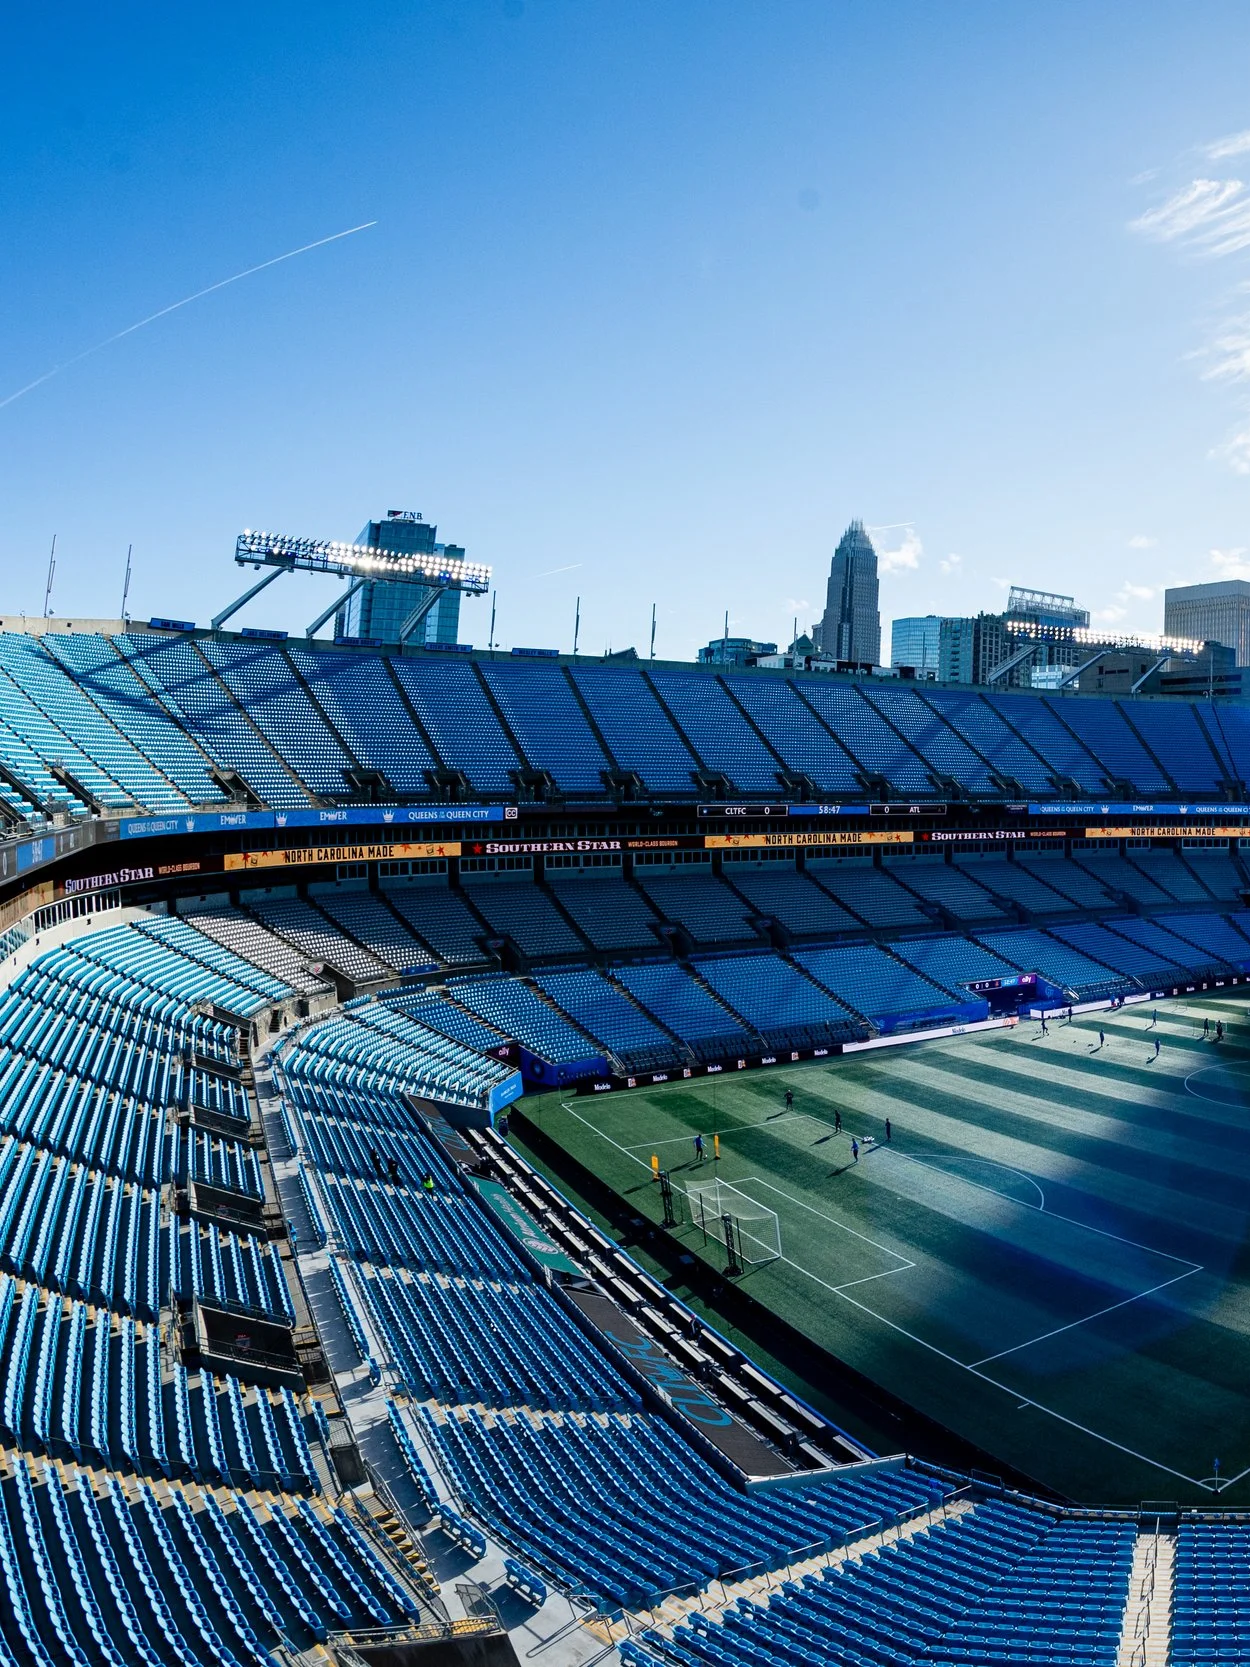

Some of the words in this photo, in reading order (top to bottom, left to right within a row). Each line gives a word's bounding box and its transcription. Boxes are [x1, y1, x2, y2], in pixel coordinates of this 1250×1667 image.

[725, 807, 746, 815] CLTFC
[764, 806, 770, 815] 0
[818, 805, 841, 814] 58:47
[408, 811, 438, 820] QUEENS
[446, 810, 472, 820] QUEEN
[472, 810, 489, 818] CITY
[128, 822, 147, 835] QUEENS
[151, 821, 166, 833] QUEEN
[166, 820, 179, 830] CITY
[1131, 828, 1155, 836] NORTH
[1157, 828, 1192, 836] CAROLINA
[1195, 827, 1216, 836] MADE
[765, 834, 793, 845] NORTH
[796, 833, 837, 844] CAROLINA
[840, 832, 862, 843] MADE
[931, 832, 995, 841] SOUTHERN
[995, 830, 1026, 839] STAR
[486, 842, 575, 854] SOUTHERN
[577, 840, 622, 850] STAR
[285, 849, 313, 863] NORTH
[317, 846, 364, 861] CAROLINA
[367, 845, 395, 858] MADE
[65, 872, 119, 894] SOUTHERN
[120, 867, 154, 883] STAR
[498, 1046, 510, 1056] ally
[814, 1048, 829, 1056] Modelo
[761, 1056, 777, 1064] Modelo
[707, 1064, 723, 1072] Modelo
[652, 1073, 668, 1082] Modelo
[594, 1083, 611, 1091] Modelo
